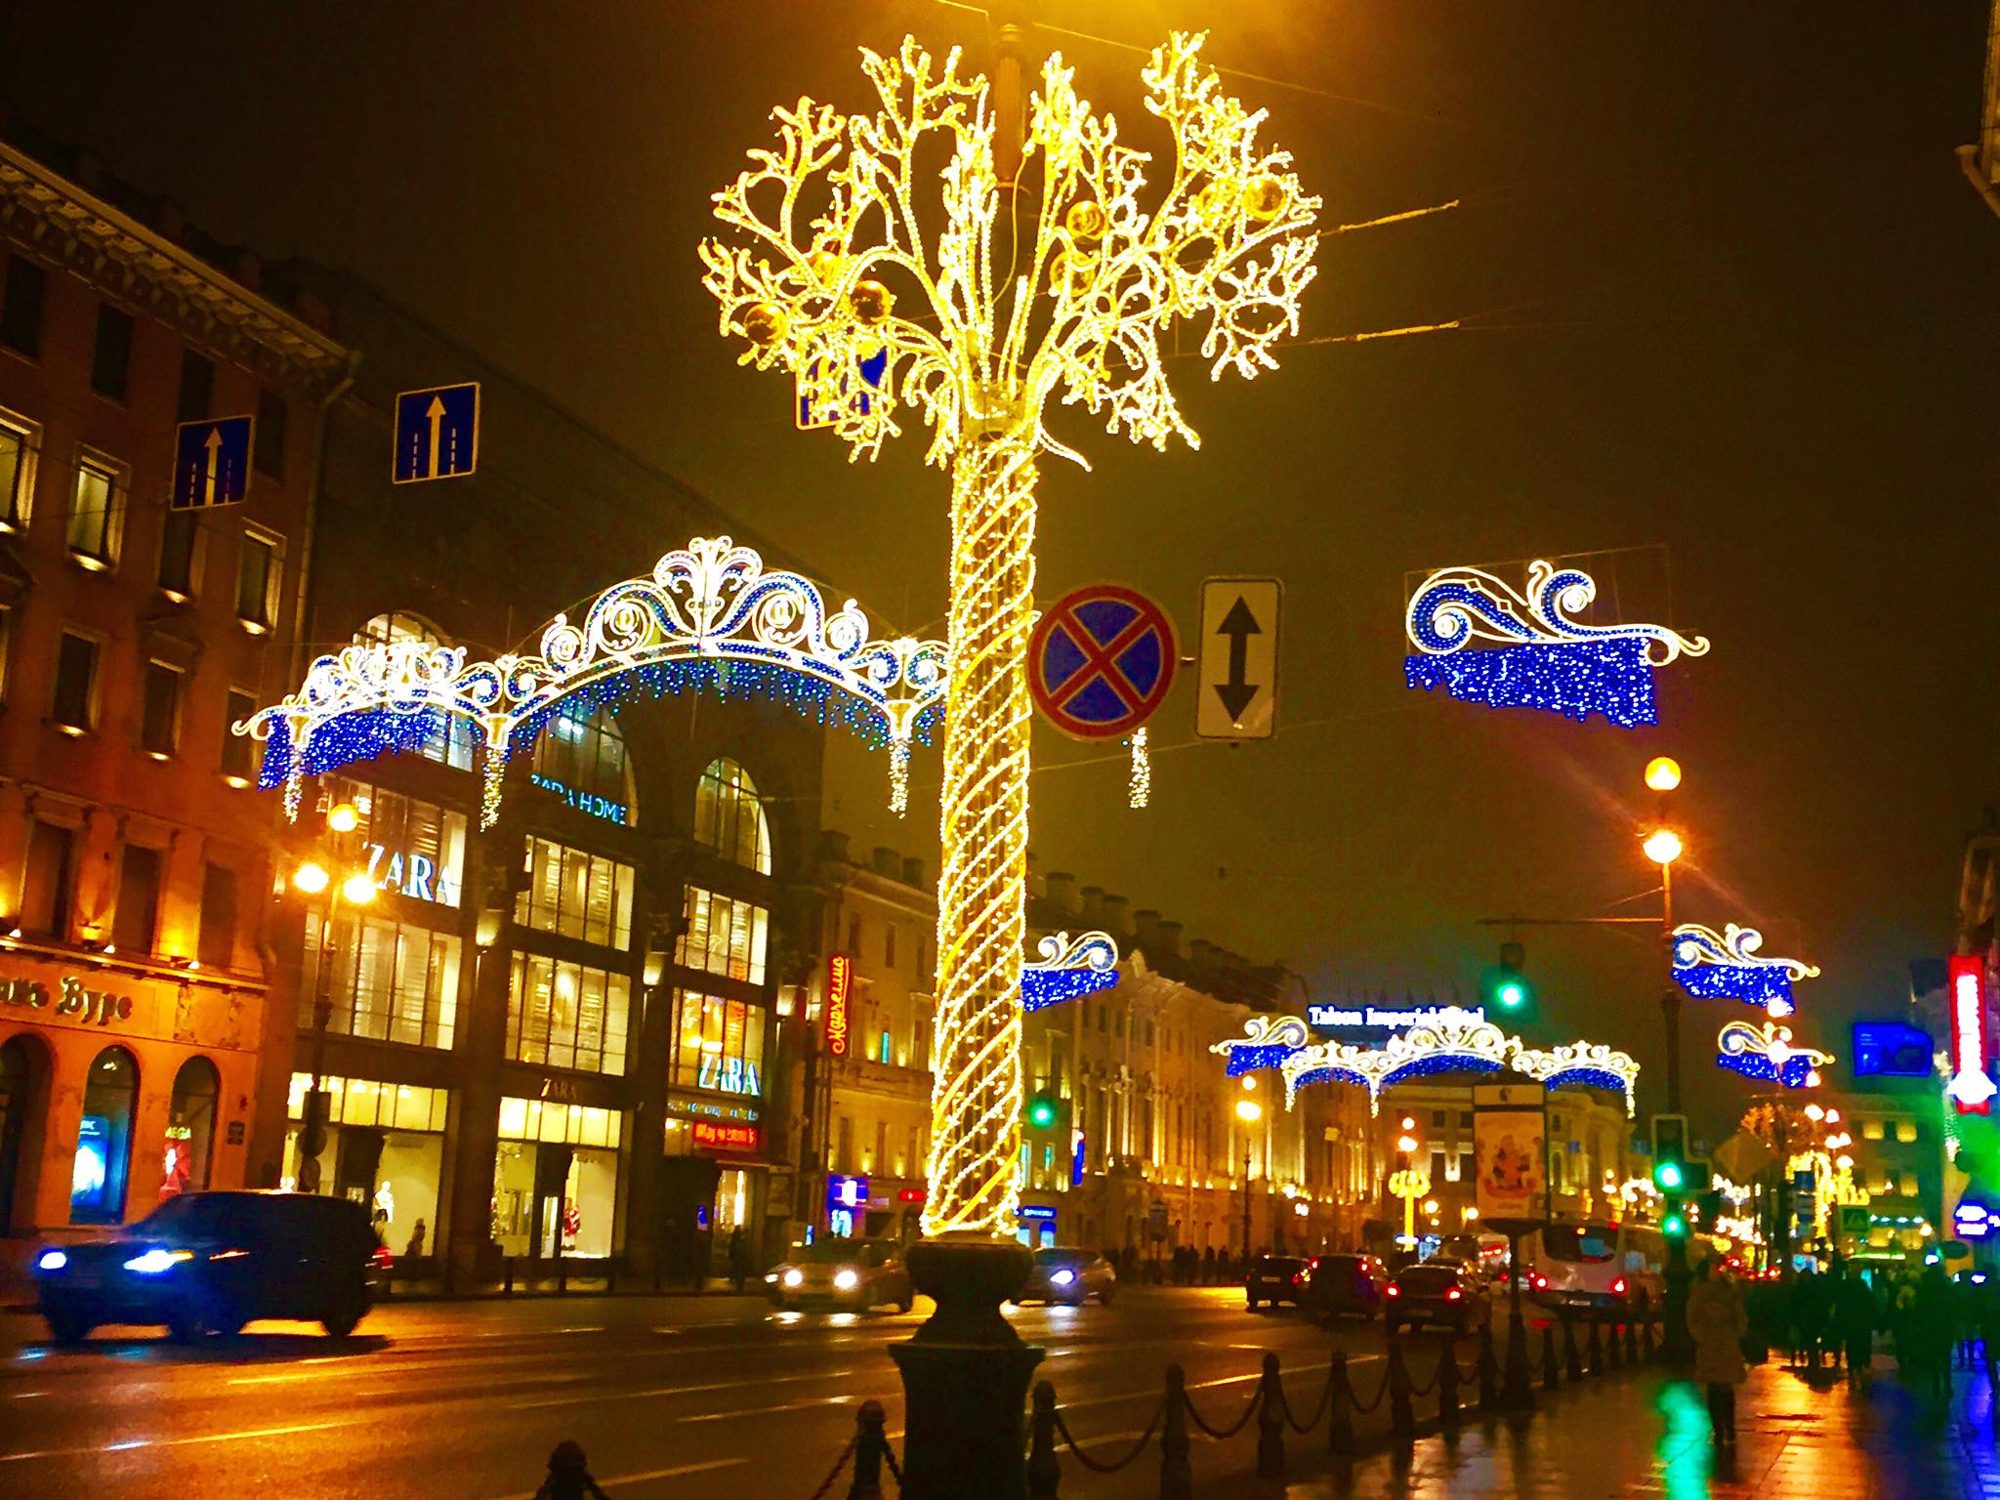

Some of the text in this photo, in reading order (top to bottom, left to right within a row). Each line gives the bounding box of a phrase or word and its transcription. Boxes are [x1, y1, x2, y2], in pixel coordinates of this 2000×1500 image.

[579, 791, 628, 826] HOME
[362, 841, 460, 910] ZARA
[698, 1052, 761, 1097] ZARA
